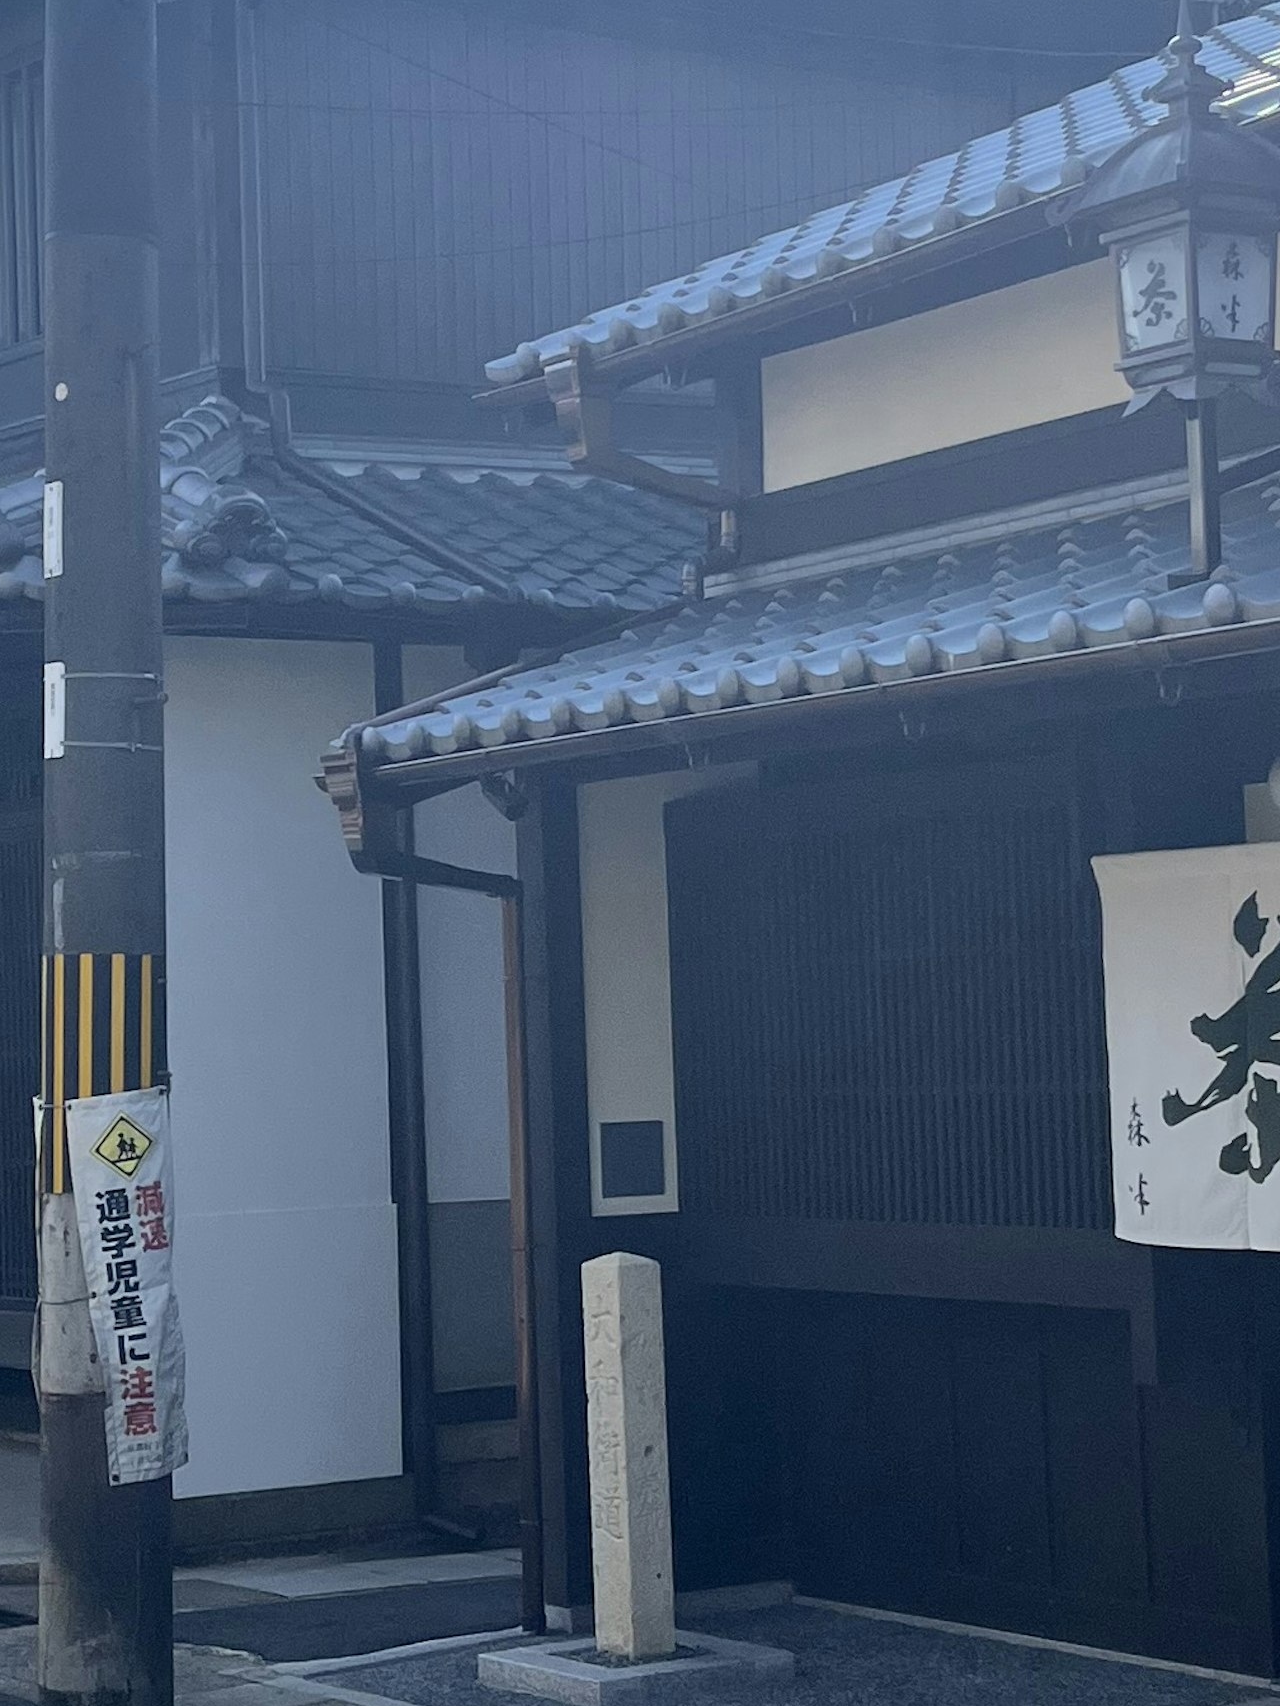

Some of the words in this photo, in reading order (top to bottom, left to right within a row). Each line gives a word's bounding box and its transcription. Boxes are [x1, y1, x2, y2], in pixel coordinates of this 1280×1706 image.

[1133, 260, 1177, 327] 茶
[134, 1182, 169, 1253] 減速
[95, 1188, 158, 1435] 通学児童に注意
[589, 1292, 624, 1540] 大和街道
